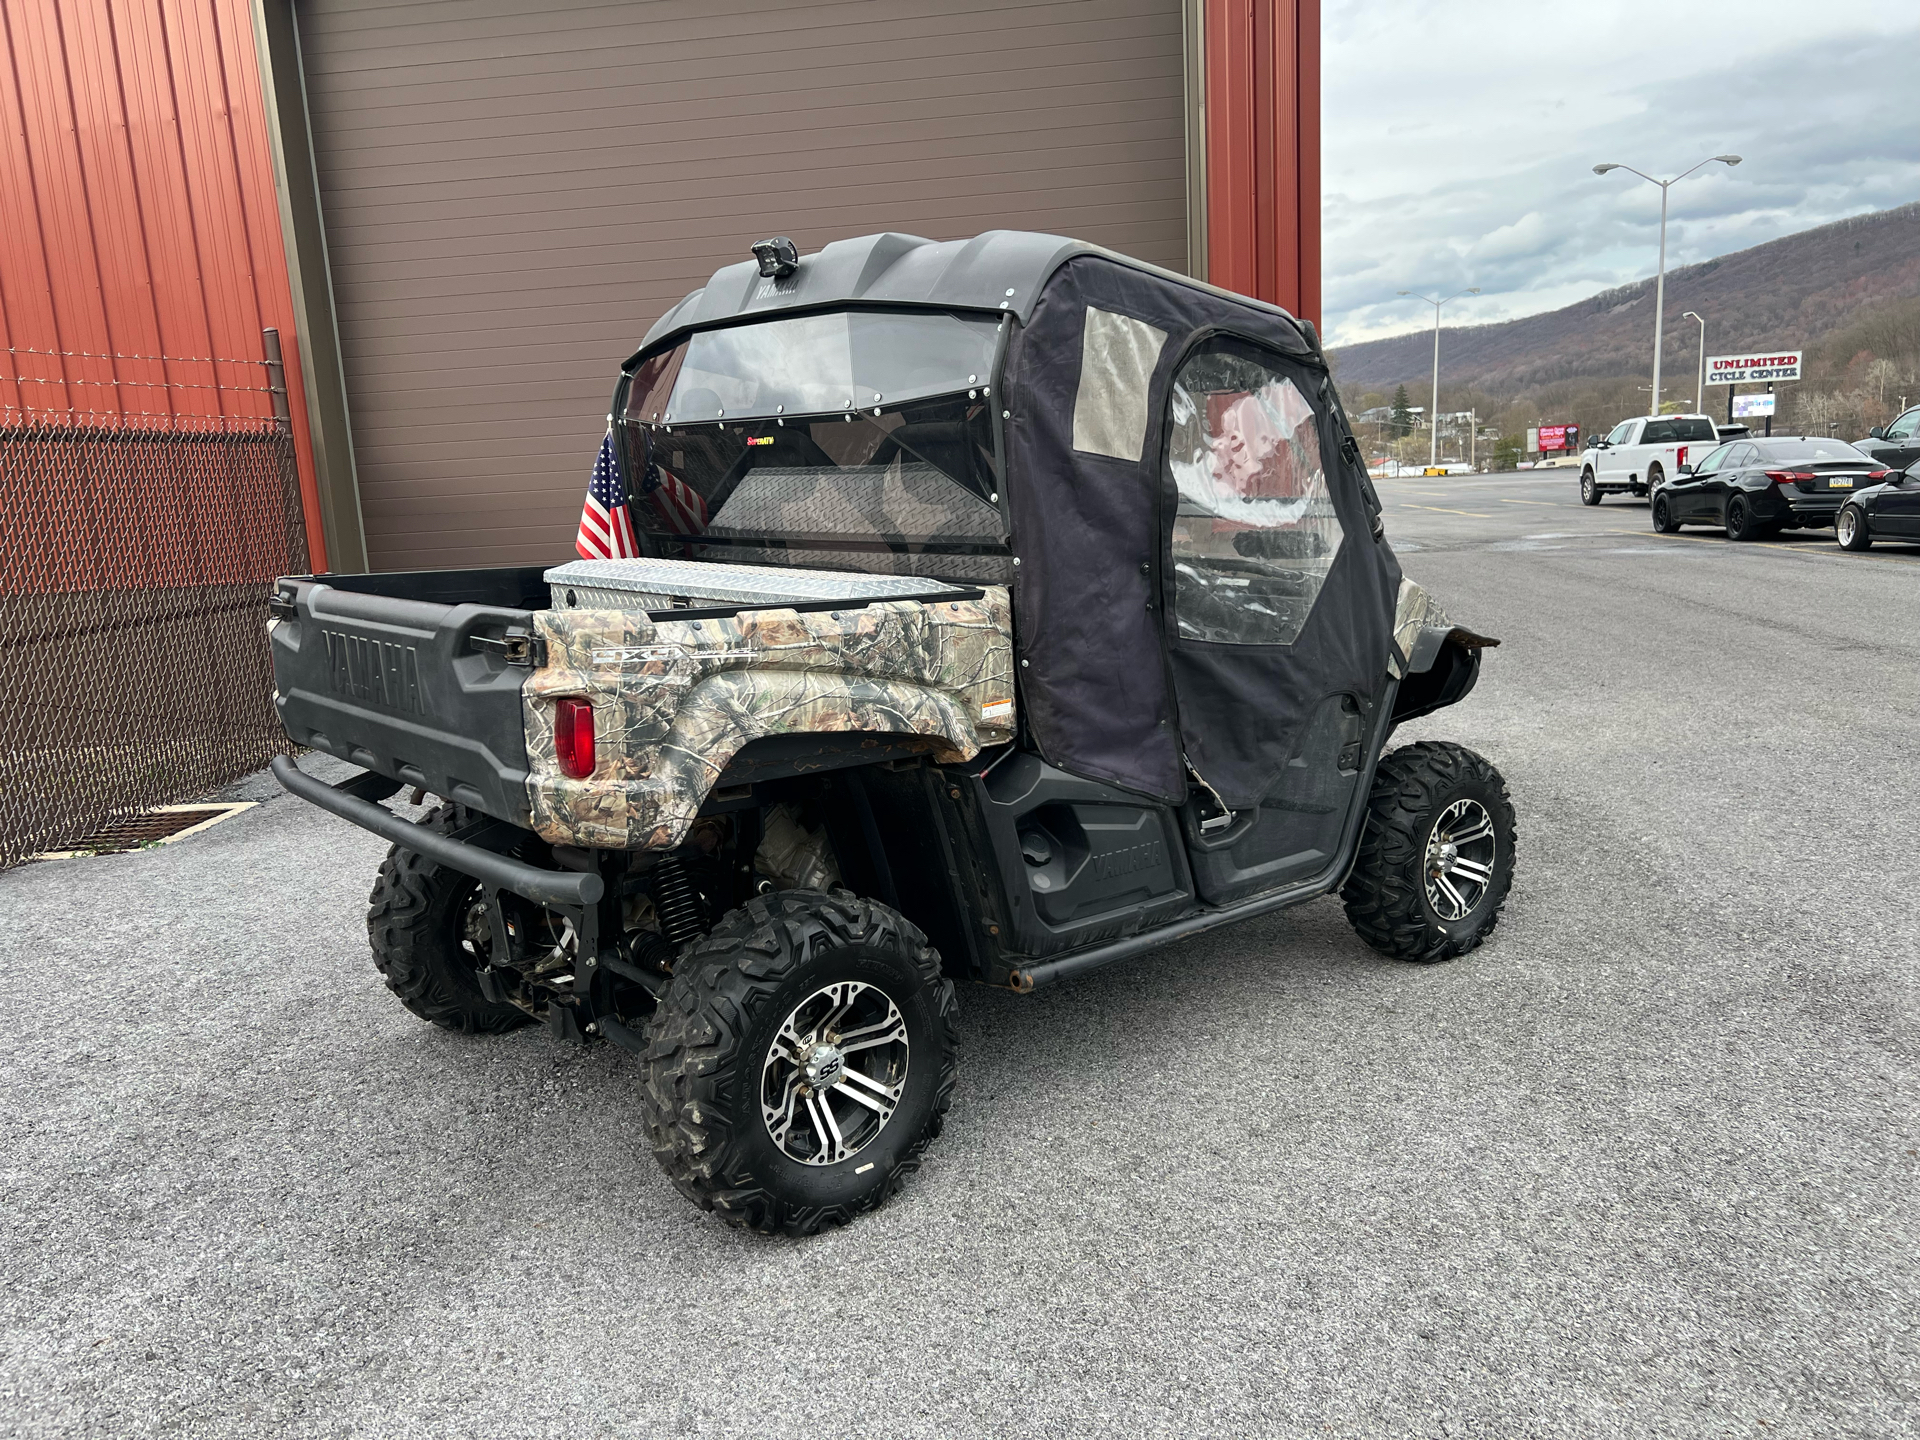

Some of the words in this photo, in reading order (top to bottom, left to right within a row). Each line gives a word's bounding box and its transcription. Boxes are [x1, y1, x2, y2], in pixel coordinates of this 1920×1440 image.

[756, 279, 800, 300] YAMAHA
[1713, 356, 1798, 370] UNLIMITED
[1709, 371, 1746, 381] CYCLE
[1750, 367, 1797, 379] CENTER
[321, 629, 426, 716] YAMAHA
[1092, 840, 1162, 882] YAMAHA
[1445, 853, 1457, 864] SS
[819, 1057, 839, 1080] SS
